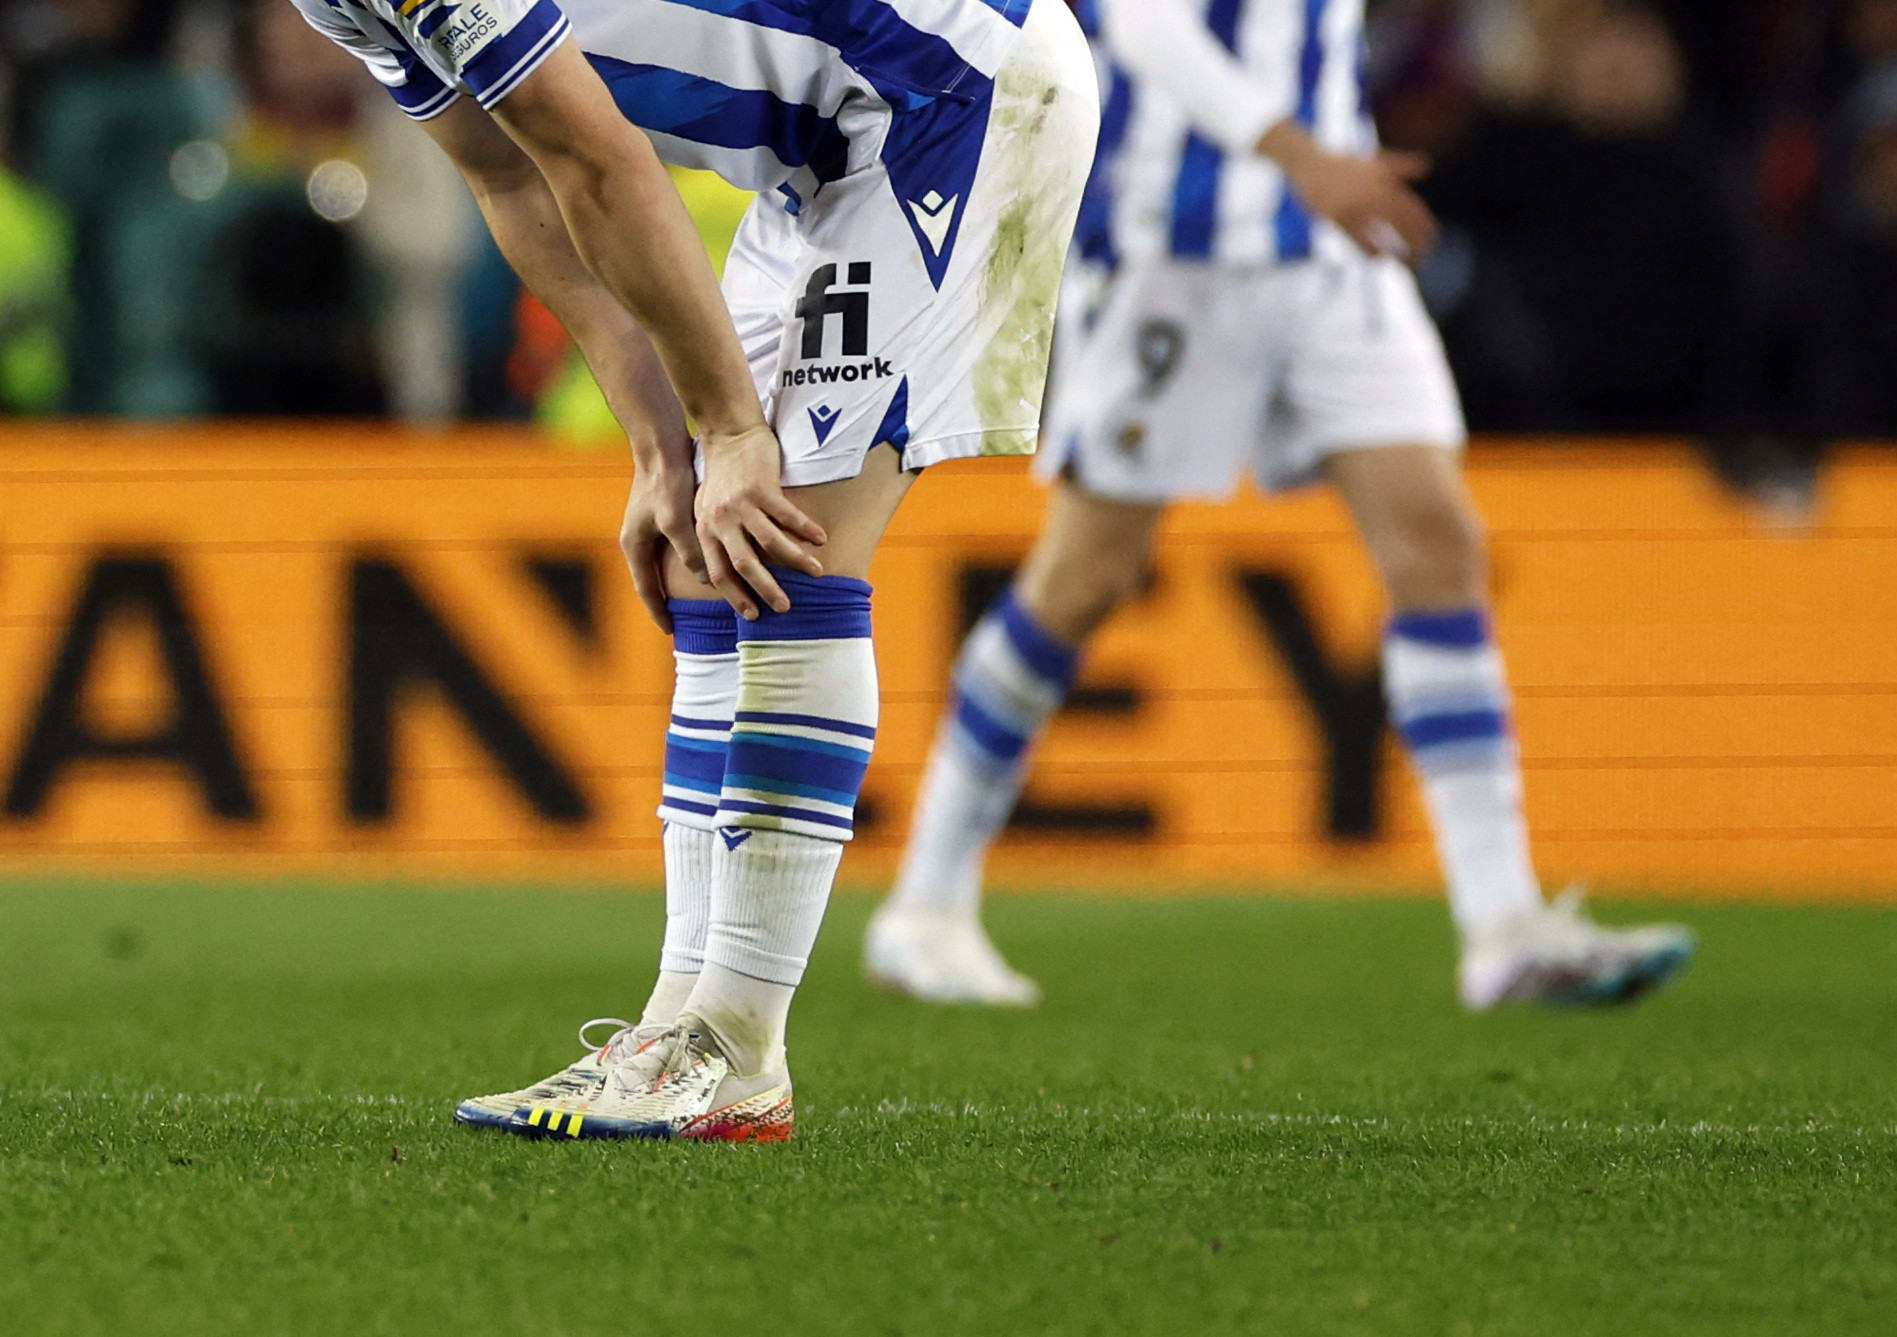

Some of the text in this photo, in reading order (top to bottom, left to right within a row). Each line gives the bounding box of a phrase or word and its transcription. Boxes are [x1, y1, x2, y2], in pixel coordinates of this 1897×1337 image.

[795, 261, 871, 359] fi
[782, 357, 894, 387] network
[1135, 320, 1186, 404] 9
